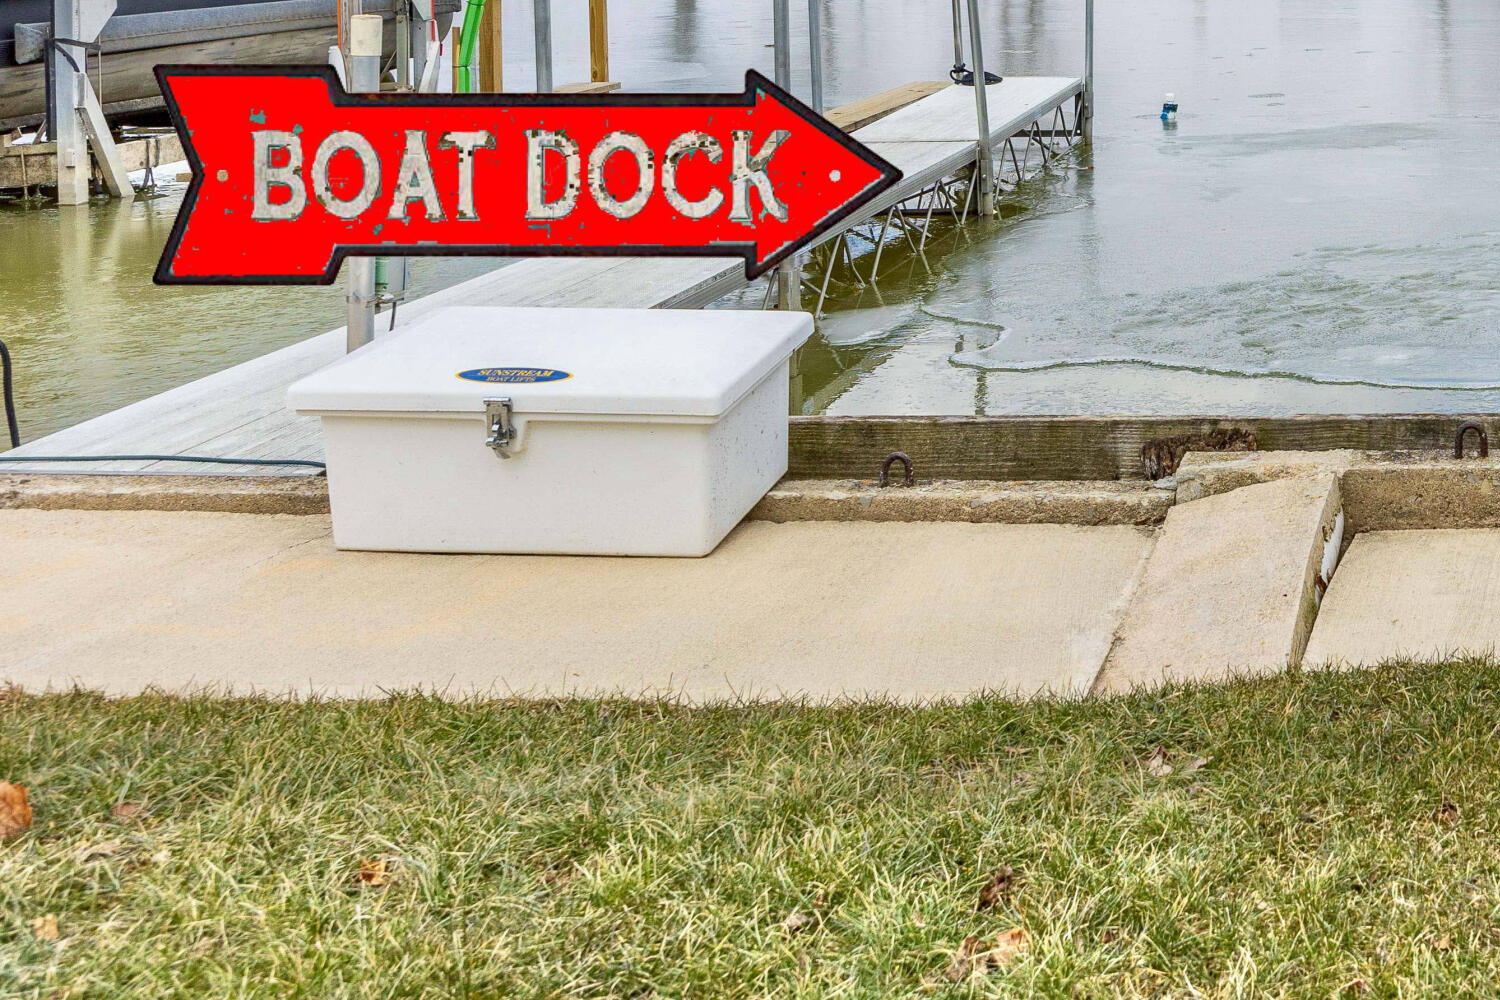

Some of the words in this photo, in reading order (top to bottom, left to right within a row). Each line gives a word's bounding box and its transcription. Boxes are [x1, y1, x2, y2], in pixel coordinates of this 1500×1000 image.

[250, 129, 498, 222] BOAT
[524, 129, 792, 222] DOCK
[478, 369, 554, 377] SUNSTREAM
